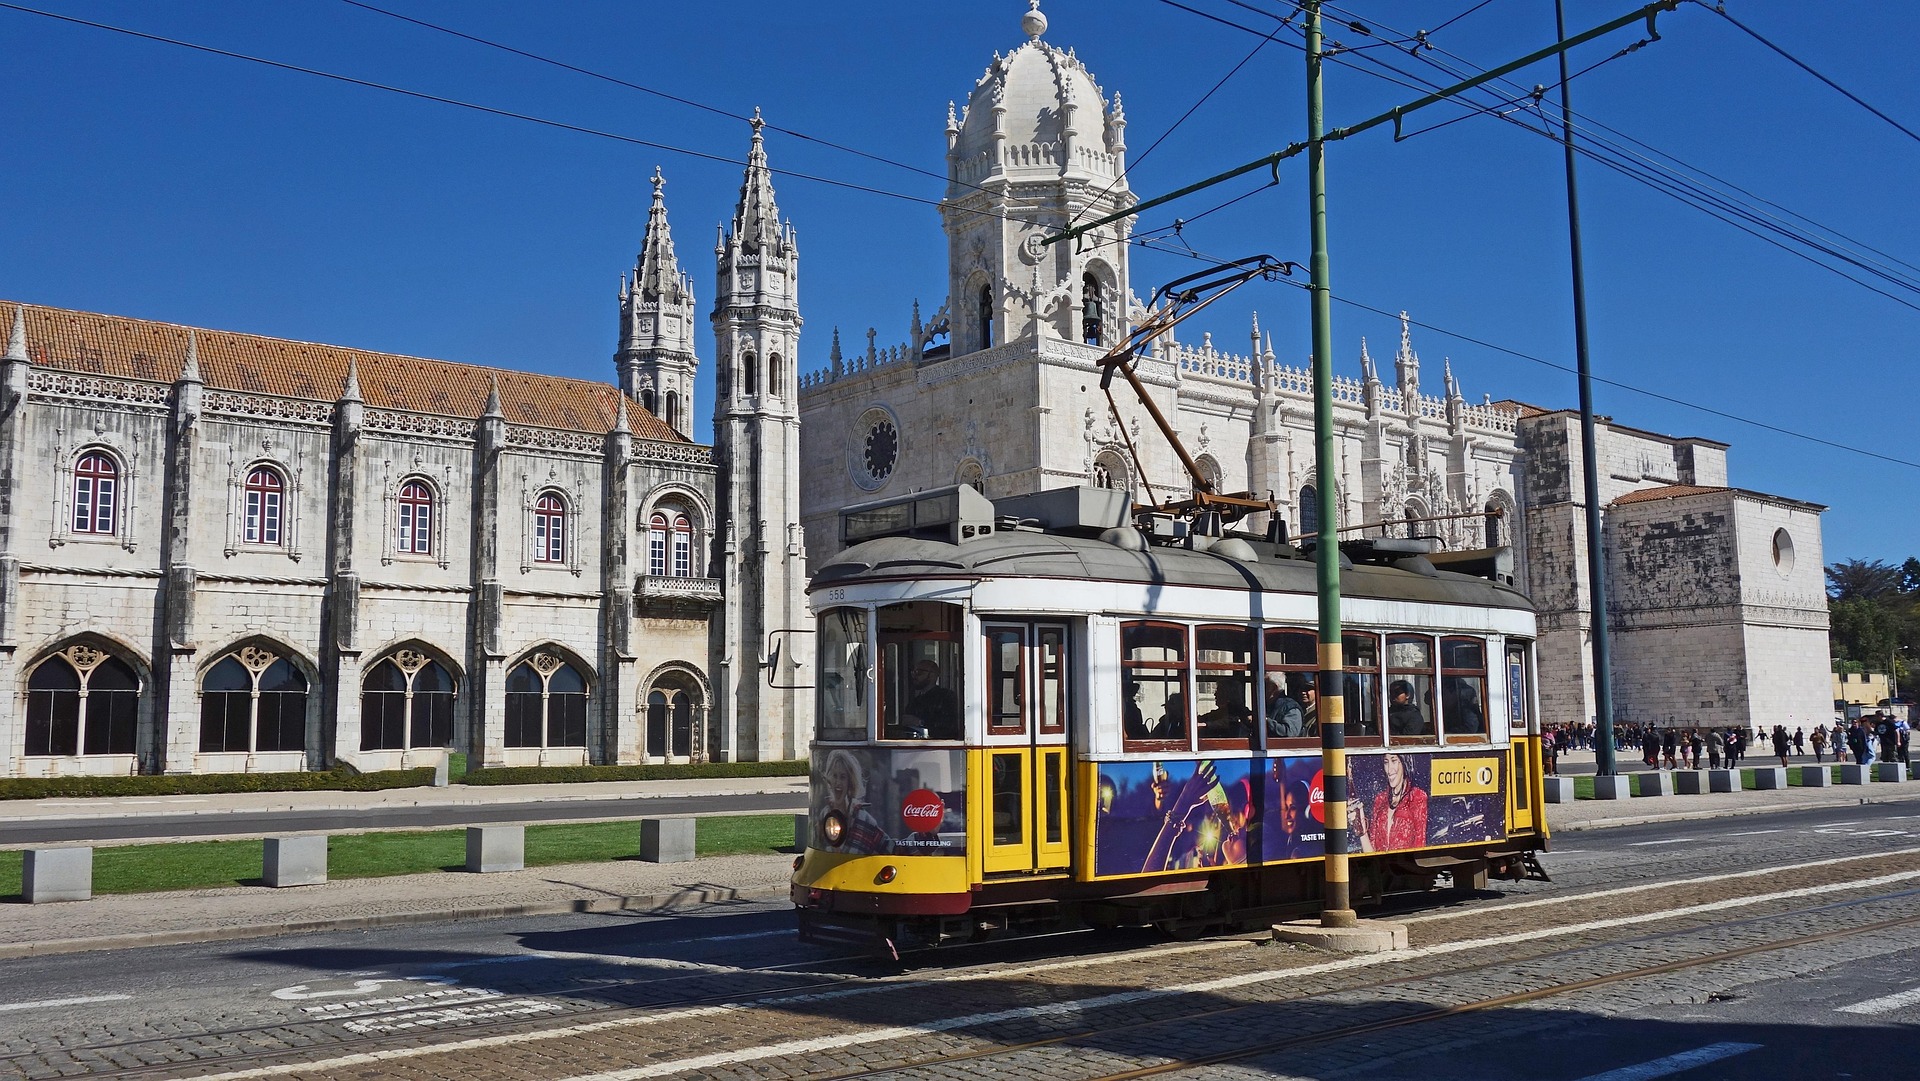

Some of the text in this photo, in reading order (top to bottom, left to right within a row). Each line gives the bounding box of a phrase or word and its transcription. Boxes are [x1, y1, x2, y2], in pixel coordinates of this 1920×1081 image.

[829, 588, 845, 601] 558
[1438, 766, 1472, 784] carris
[1300, 834, 1317, 842] TASTE
